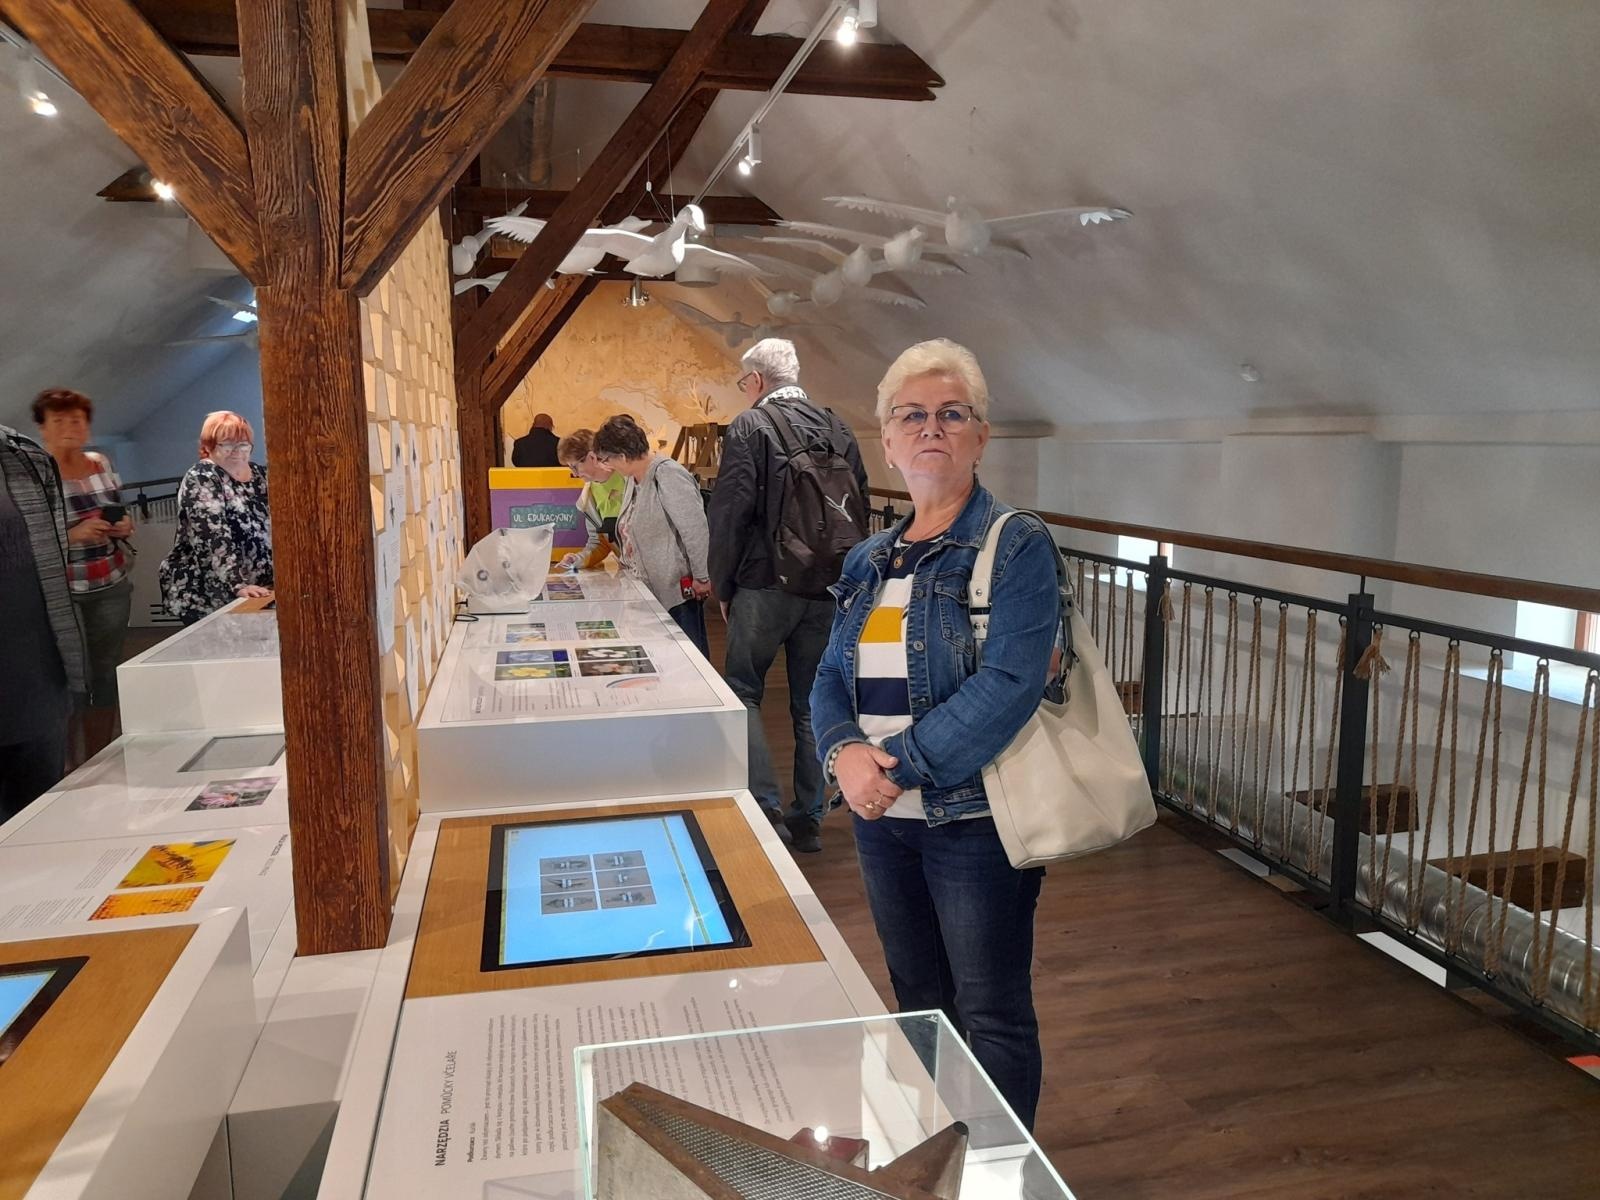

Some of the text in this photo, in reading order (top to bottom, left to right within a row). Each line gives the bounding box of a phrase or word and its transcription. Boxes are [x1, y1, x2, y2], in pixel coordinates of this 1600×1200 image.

[514, 513, 573, 522] UL EDUKACYJNY
[434, 1119, 451, 1167] NARZĘDZIA
